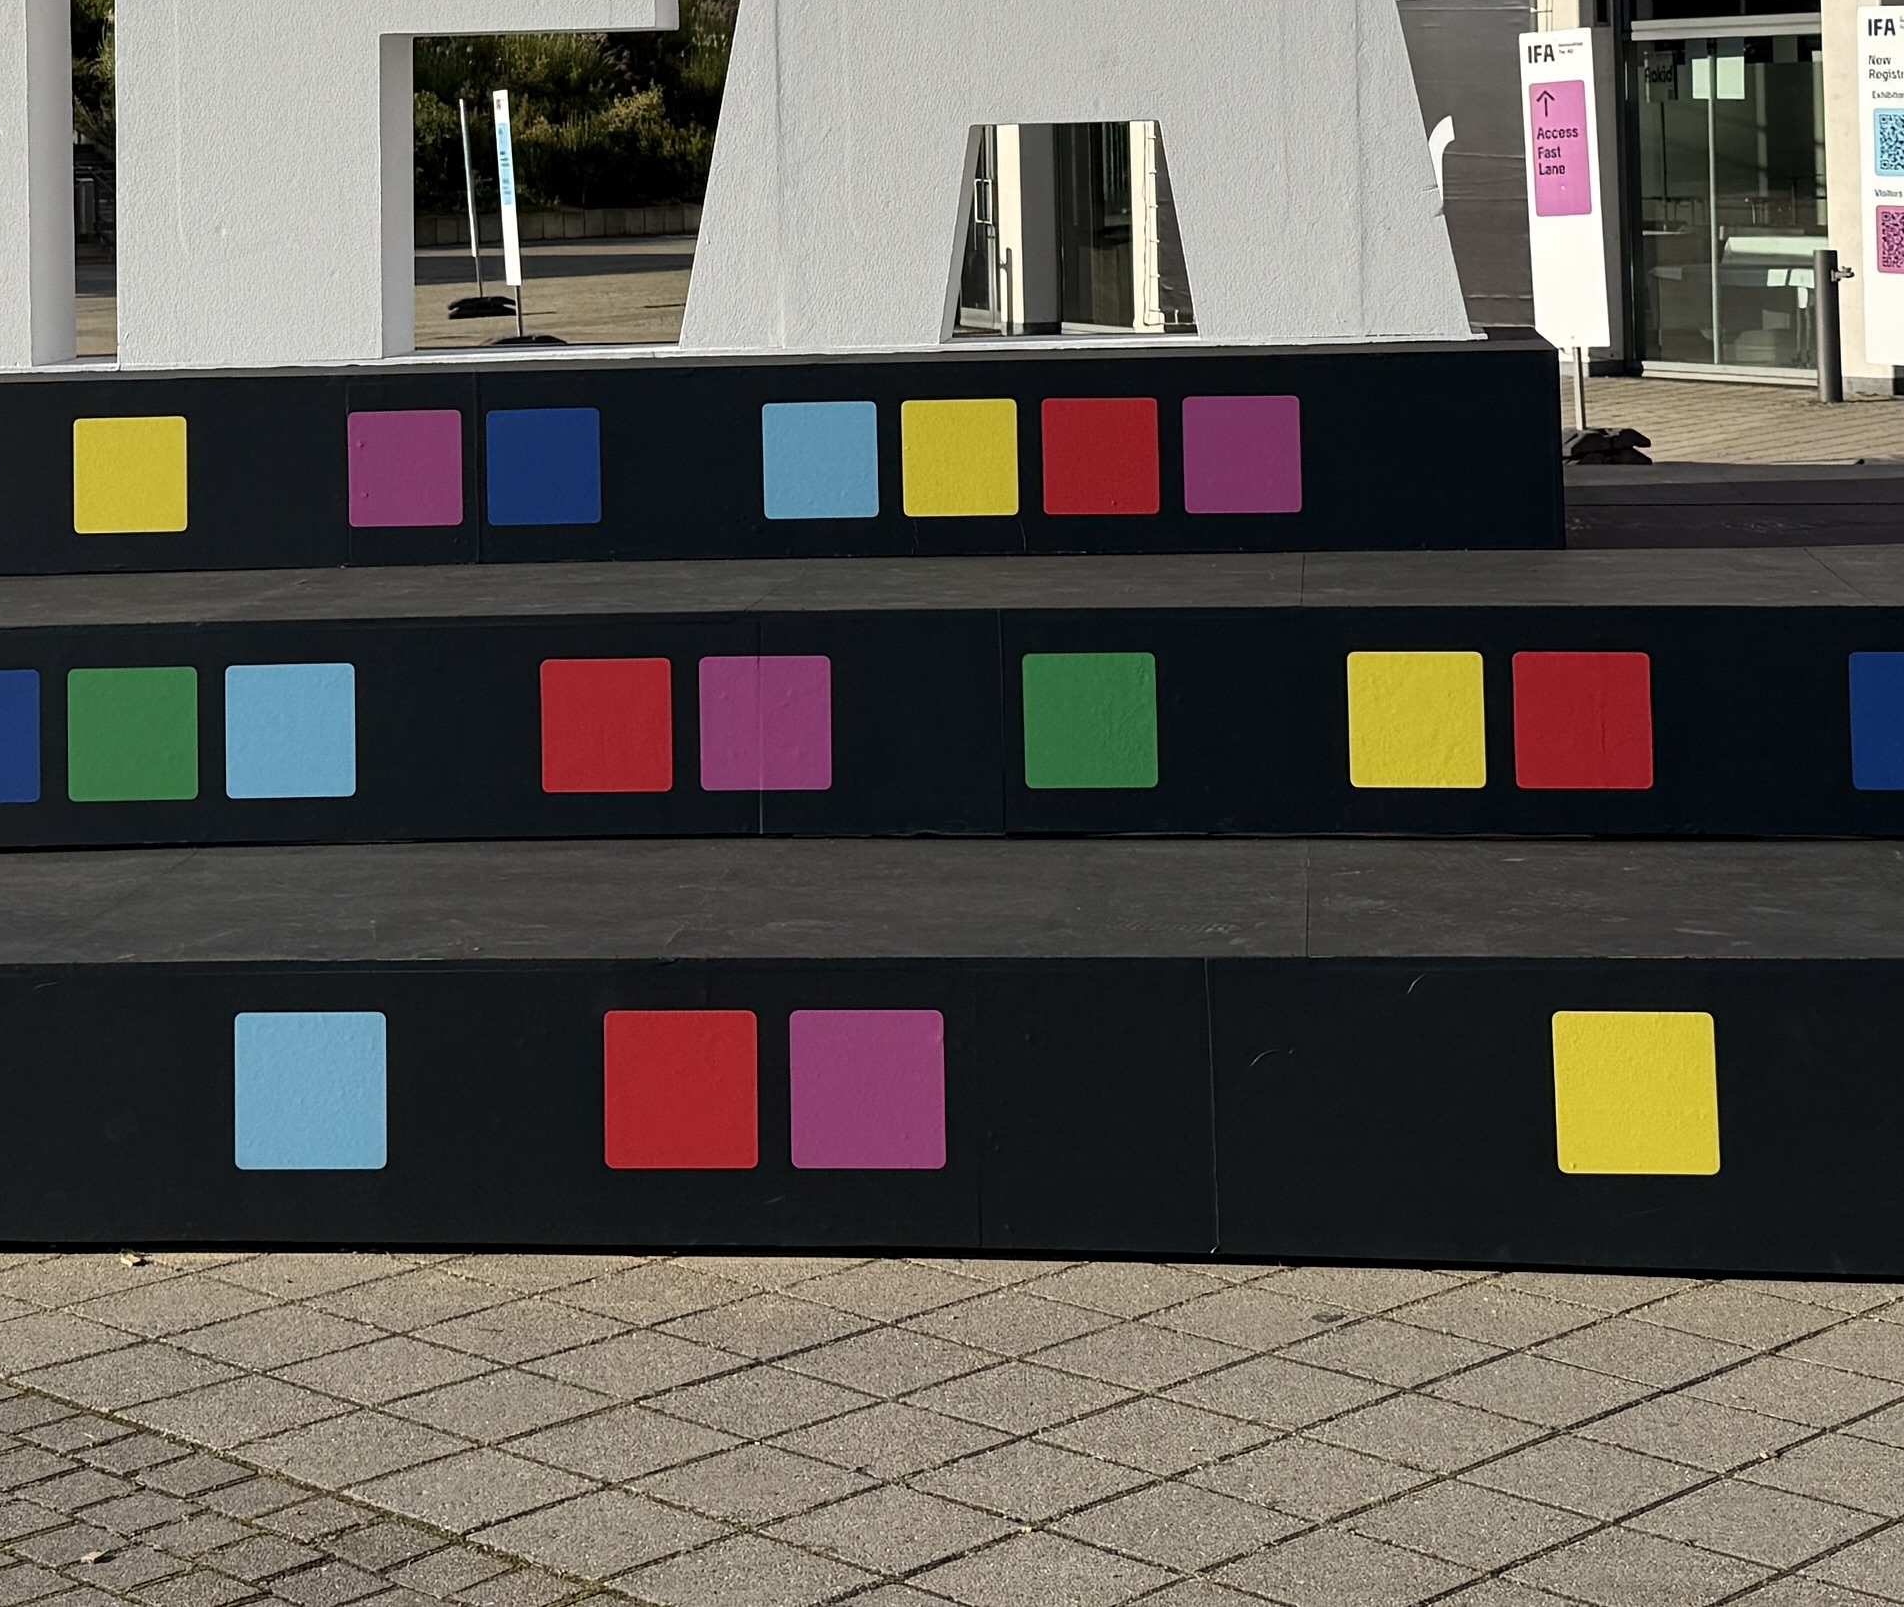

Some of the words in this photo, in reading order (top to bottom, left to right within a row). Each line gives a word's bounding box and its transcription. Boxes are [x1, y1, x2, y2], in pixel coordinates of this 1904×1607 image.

[1868, 18, 1896, 37] IFA
[1527, 43, 1555, 64] IFA
[1536, 127, 1579, 140] Access
[1537, 146, 1561, 159] Fast
[1538, 162, 1566, 176] Lane
